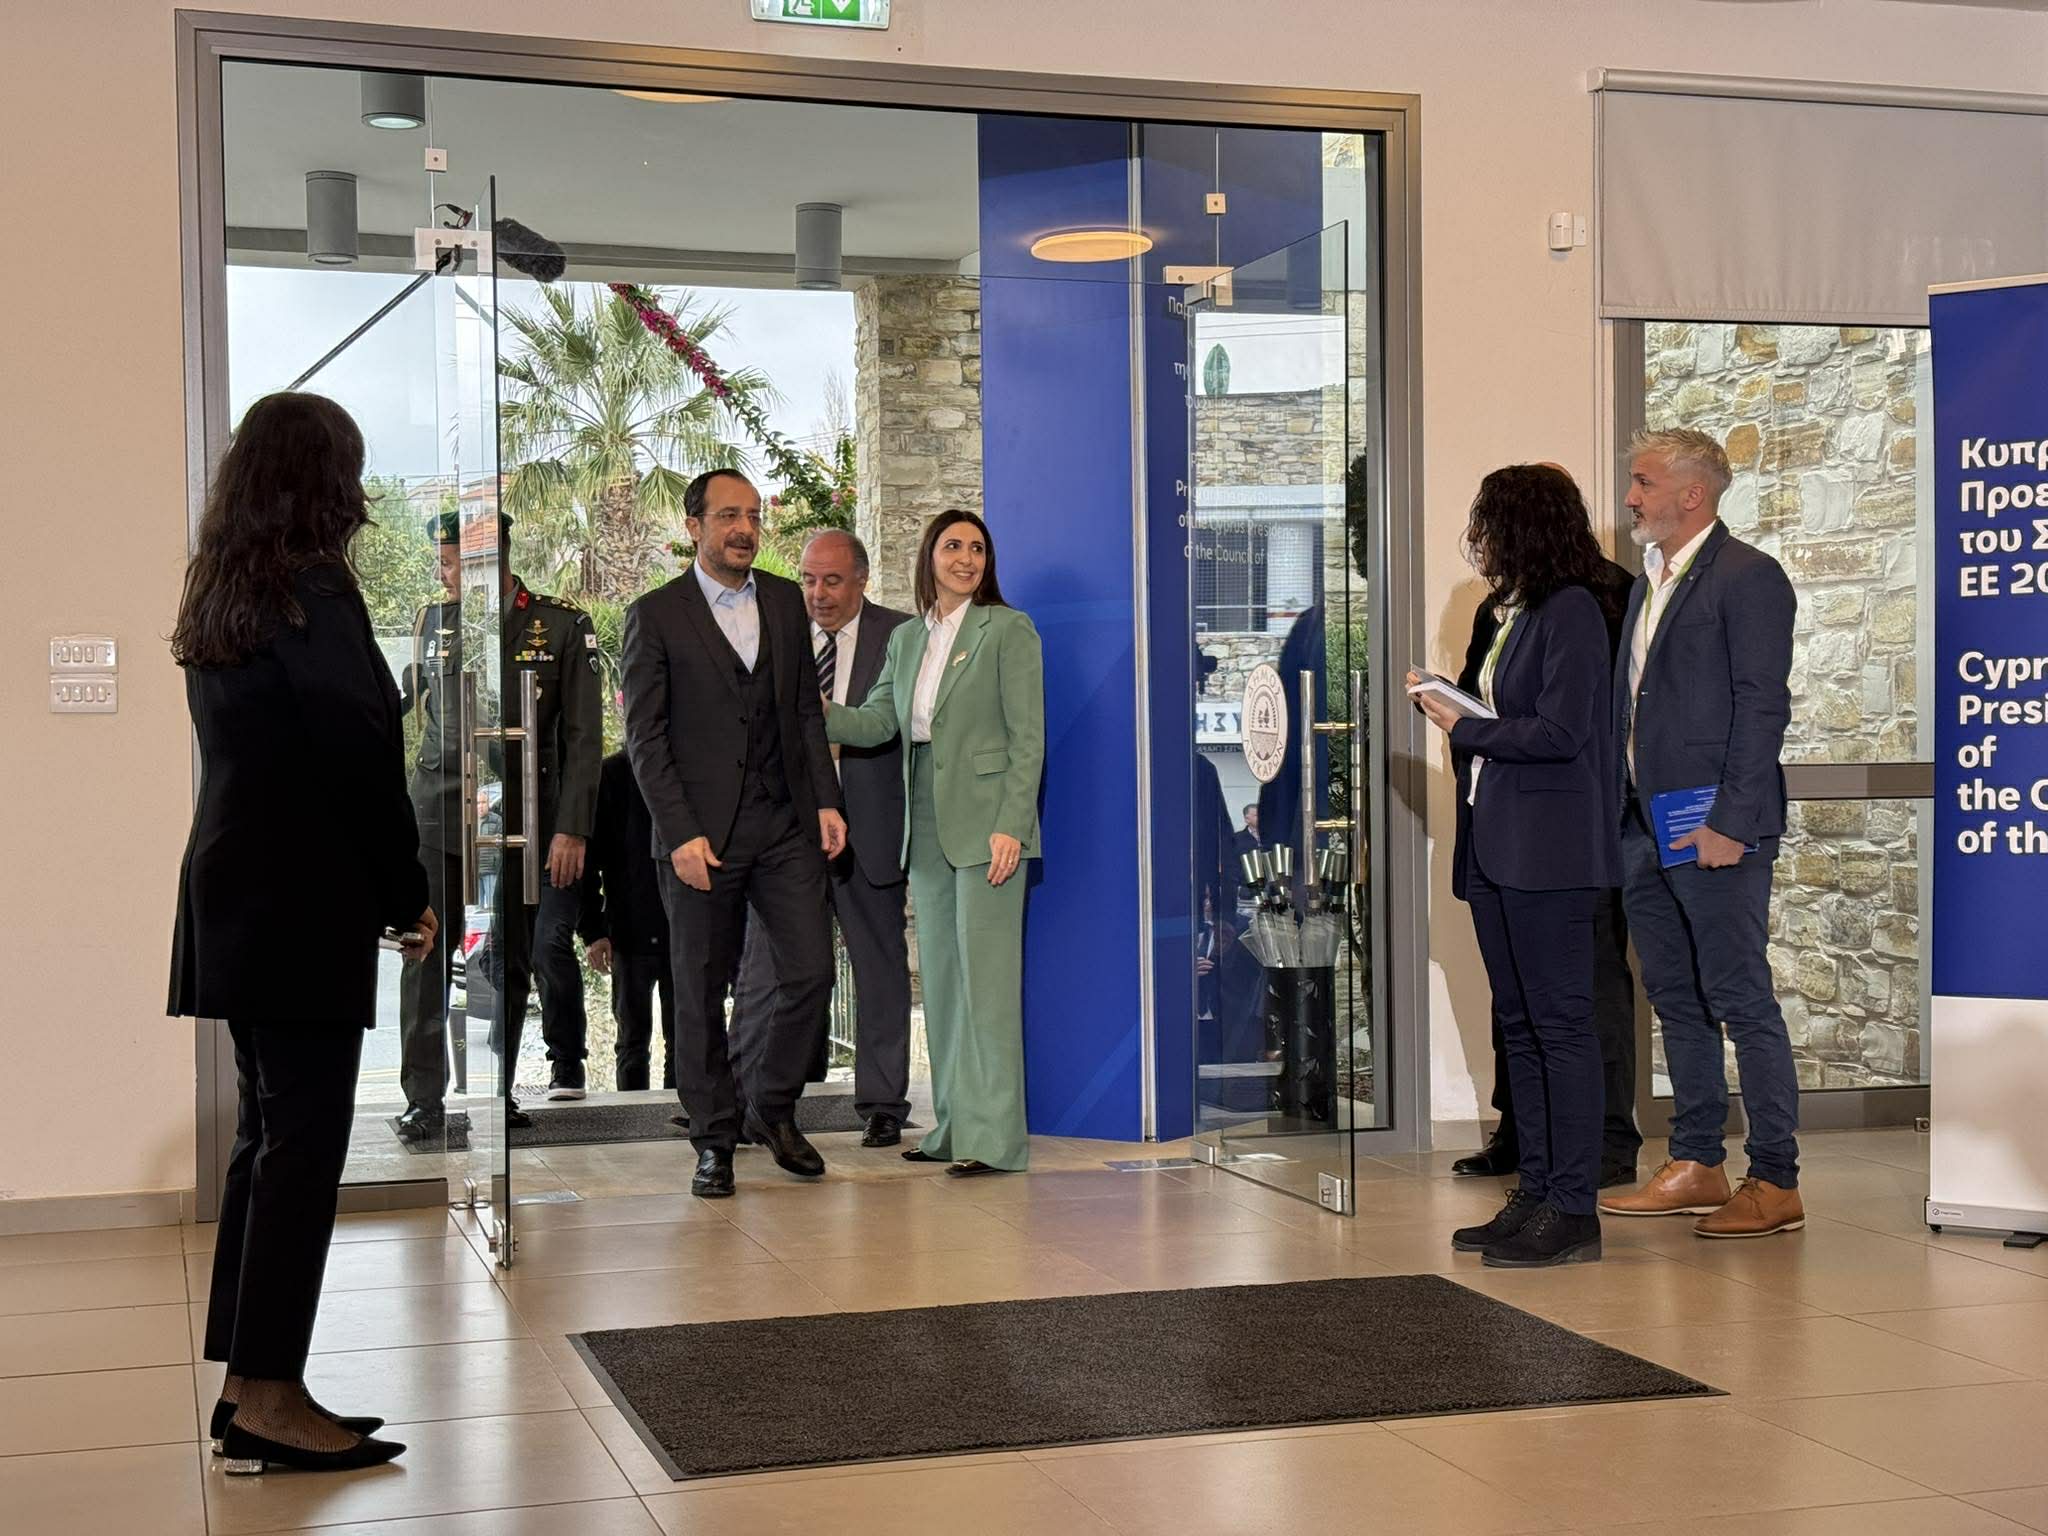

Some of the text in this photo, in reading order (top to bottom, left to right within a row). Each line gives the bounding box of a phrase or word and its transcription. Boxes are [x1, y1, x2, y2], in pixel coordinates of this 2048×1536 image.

[1196, 542, 1213, 560] the
[1960, 528, 2022, 554] του
[1959, 651, 2048, 690] Cypr
[1958, 735, 1997, 768] of
[1957, 778, 2021, 811] the
[1957, 821, 2048, 854] of th
